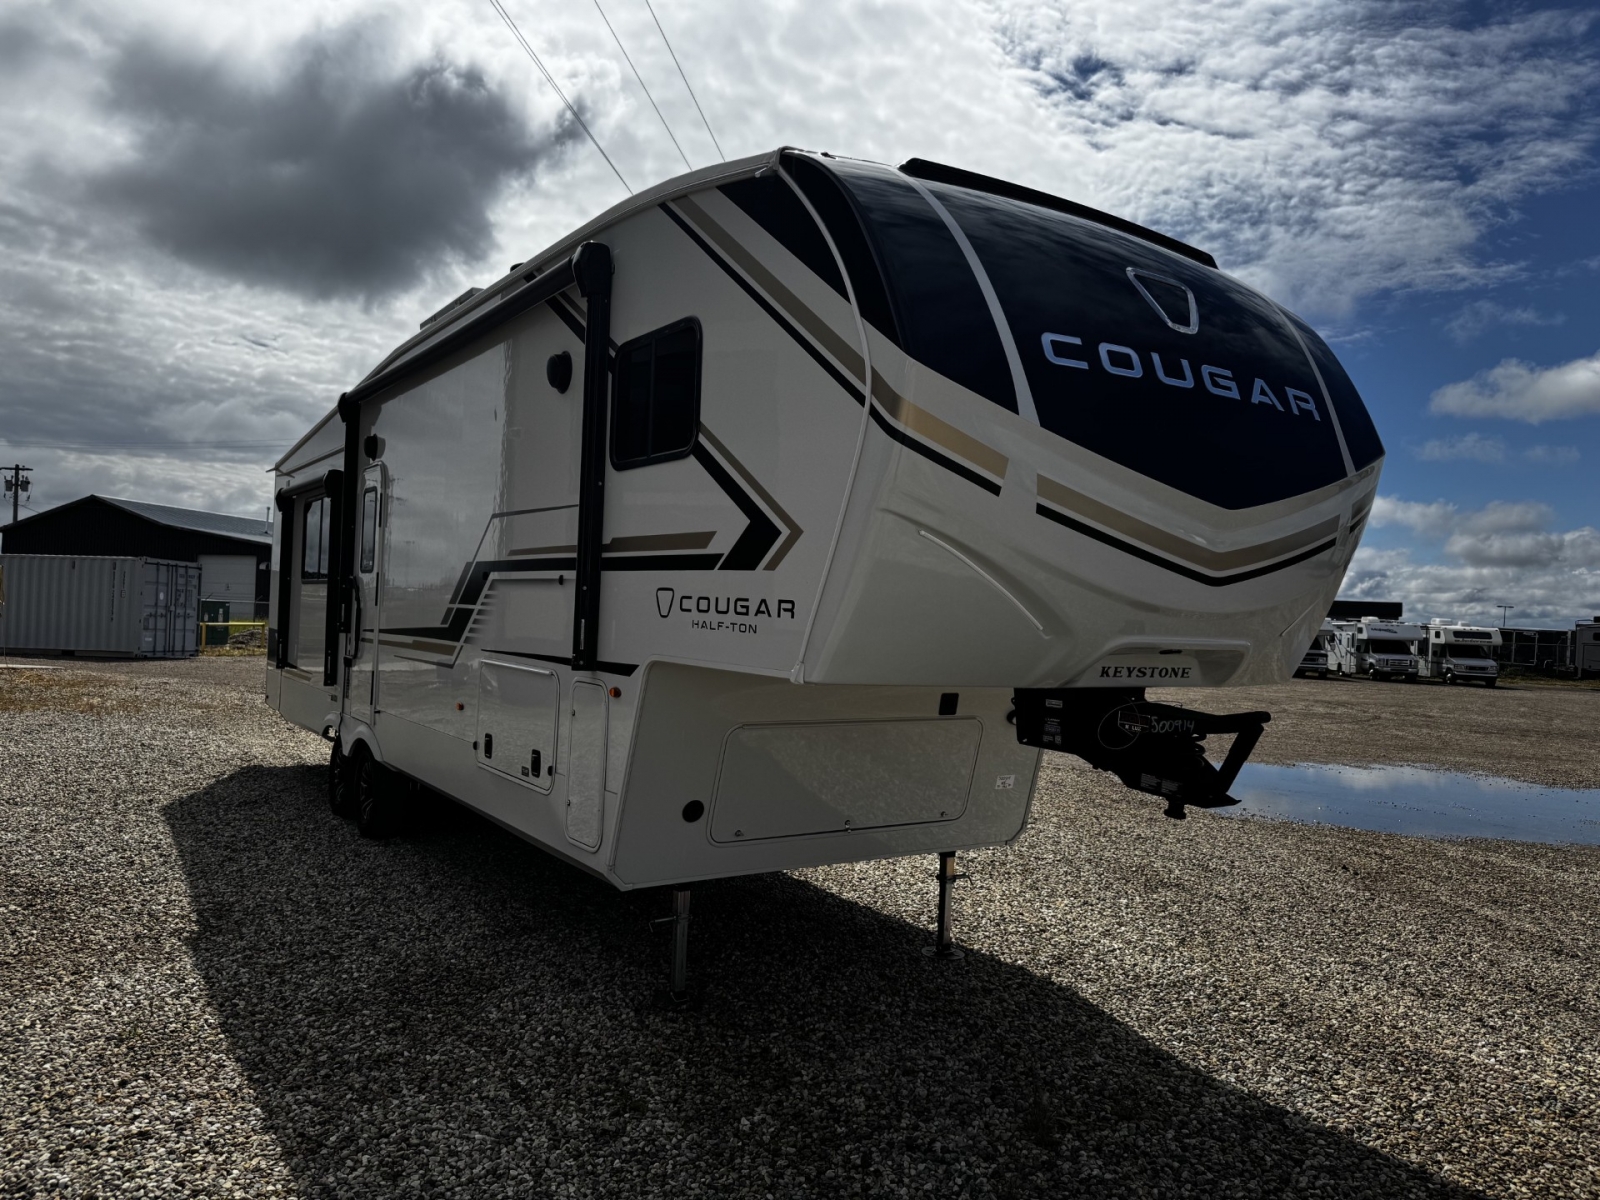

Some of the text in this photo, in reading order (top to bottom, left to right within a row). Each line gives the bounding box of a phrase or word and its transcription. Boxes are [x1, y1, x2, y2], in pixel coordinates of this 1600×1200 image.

[1041, 332, 1321, 421] COUGAR
[679, 595, 796, 619] COUGAR
[691, 619, 757, 634] HALF-TON
[1099, 666, 1192, 679] KEYSTONE
[1151, 715, 1195, 734] 500914
